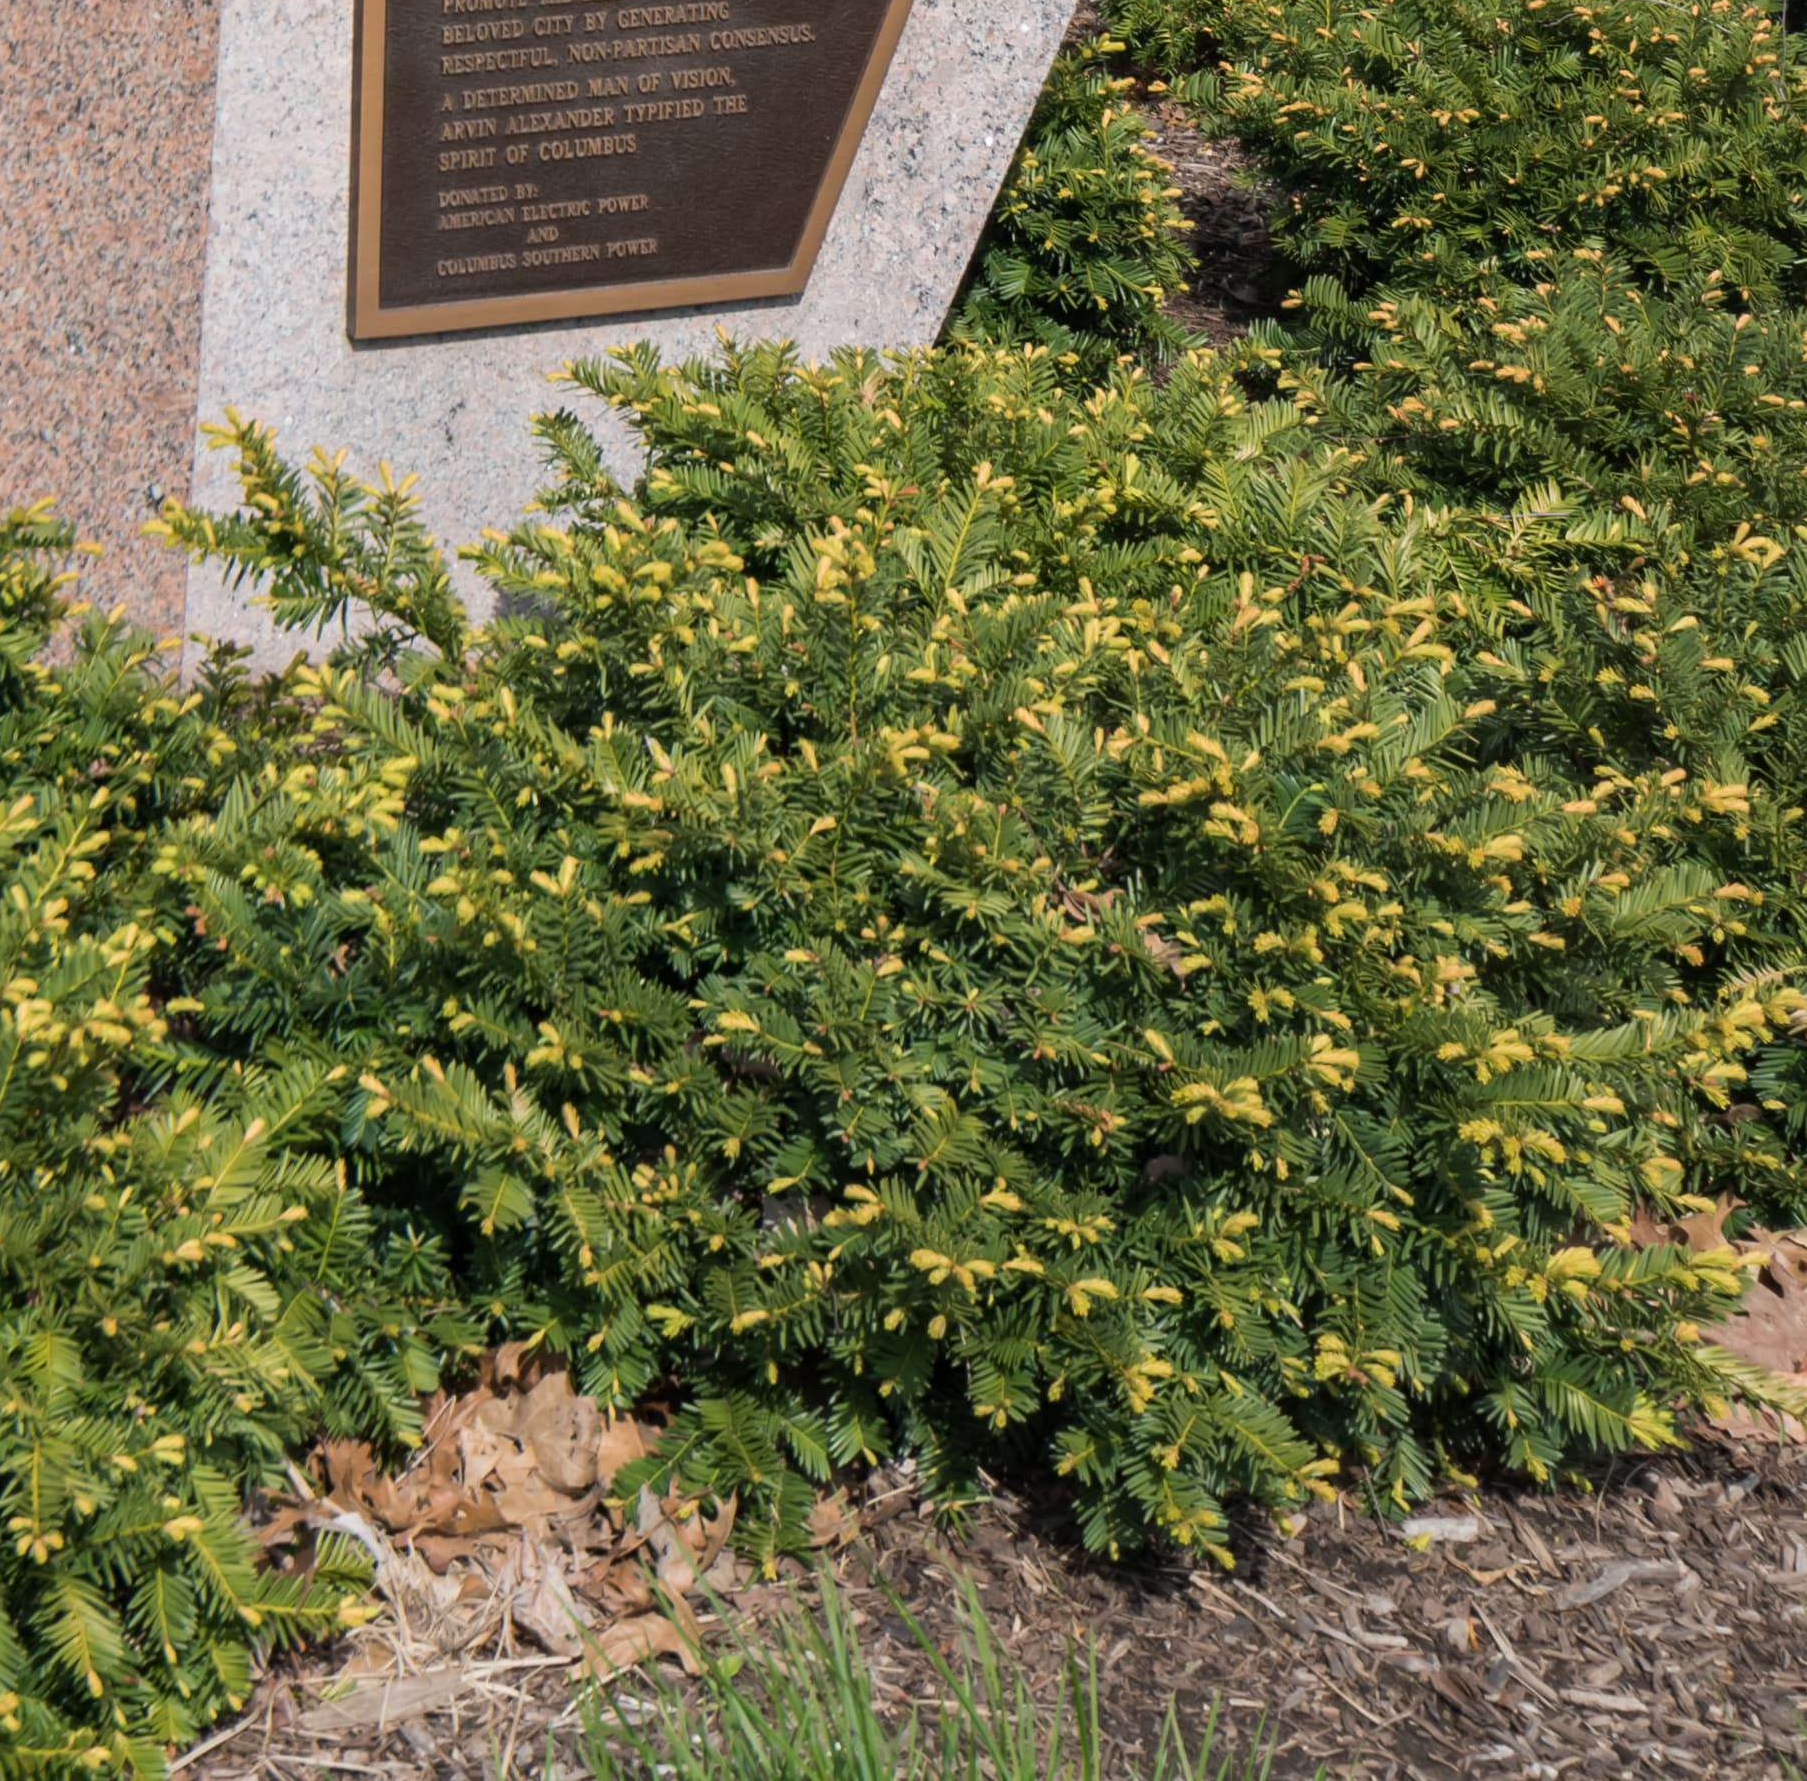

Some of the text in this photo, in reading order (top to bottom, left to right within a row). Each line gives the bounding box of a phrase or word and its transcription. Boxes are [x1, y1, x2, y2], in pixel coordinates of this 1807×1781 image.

[442, 1, 730, 44] BELOVED CITY BY GENERATING
[440, 23, 815, 74] RESPECTFUL, NON-PARTISAN CONSENSUS.
[441, 66, 736, 111] A DETERMINED MAN OF VISION,
[440, 94, 747, 141] ARVIN ALEXANDER TYPIFIED THE
[438, 133, 637, 171] SPIRIT OF COLUMBUS
[438, 183, 539, 208] DONATED BY:
[438, 194, 649, 230] AMERICAN ELECTRIC POWER
[526, 225, 560, 244] AND
[437, 238, 657, 276] COLUMBUS SOUTHERN POWER
